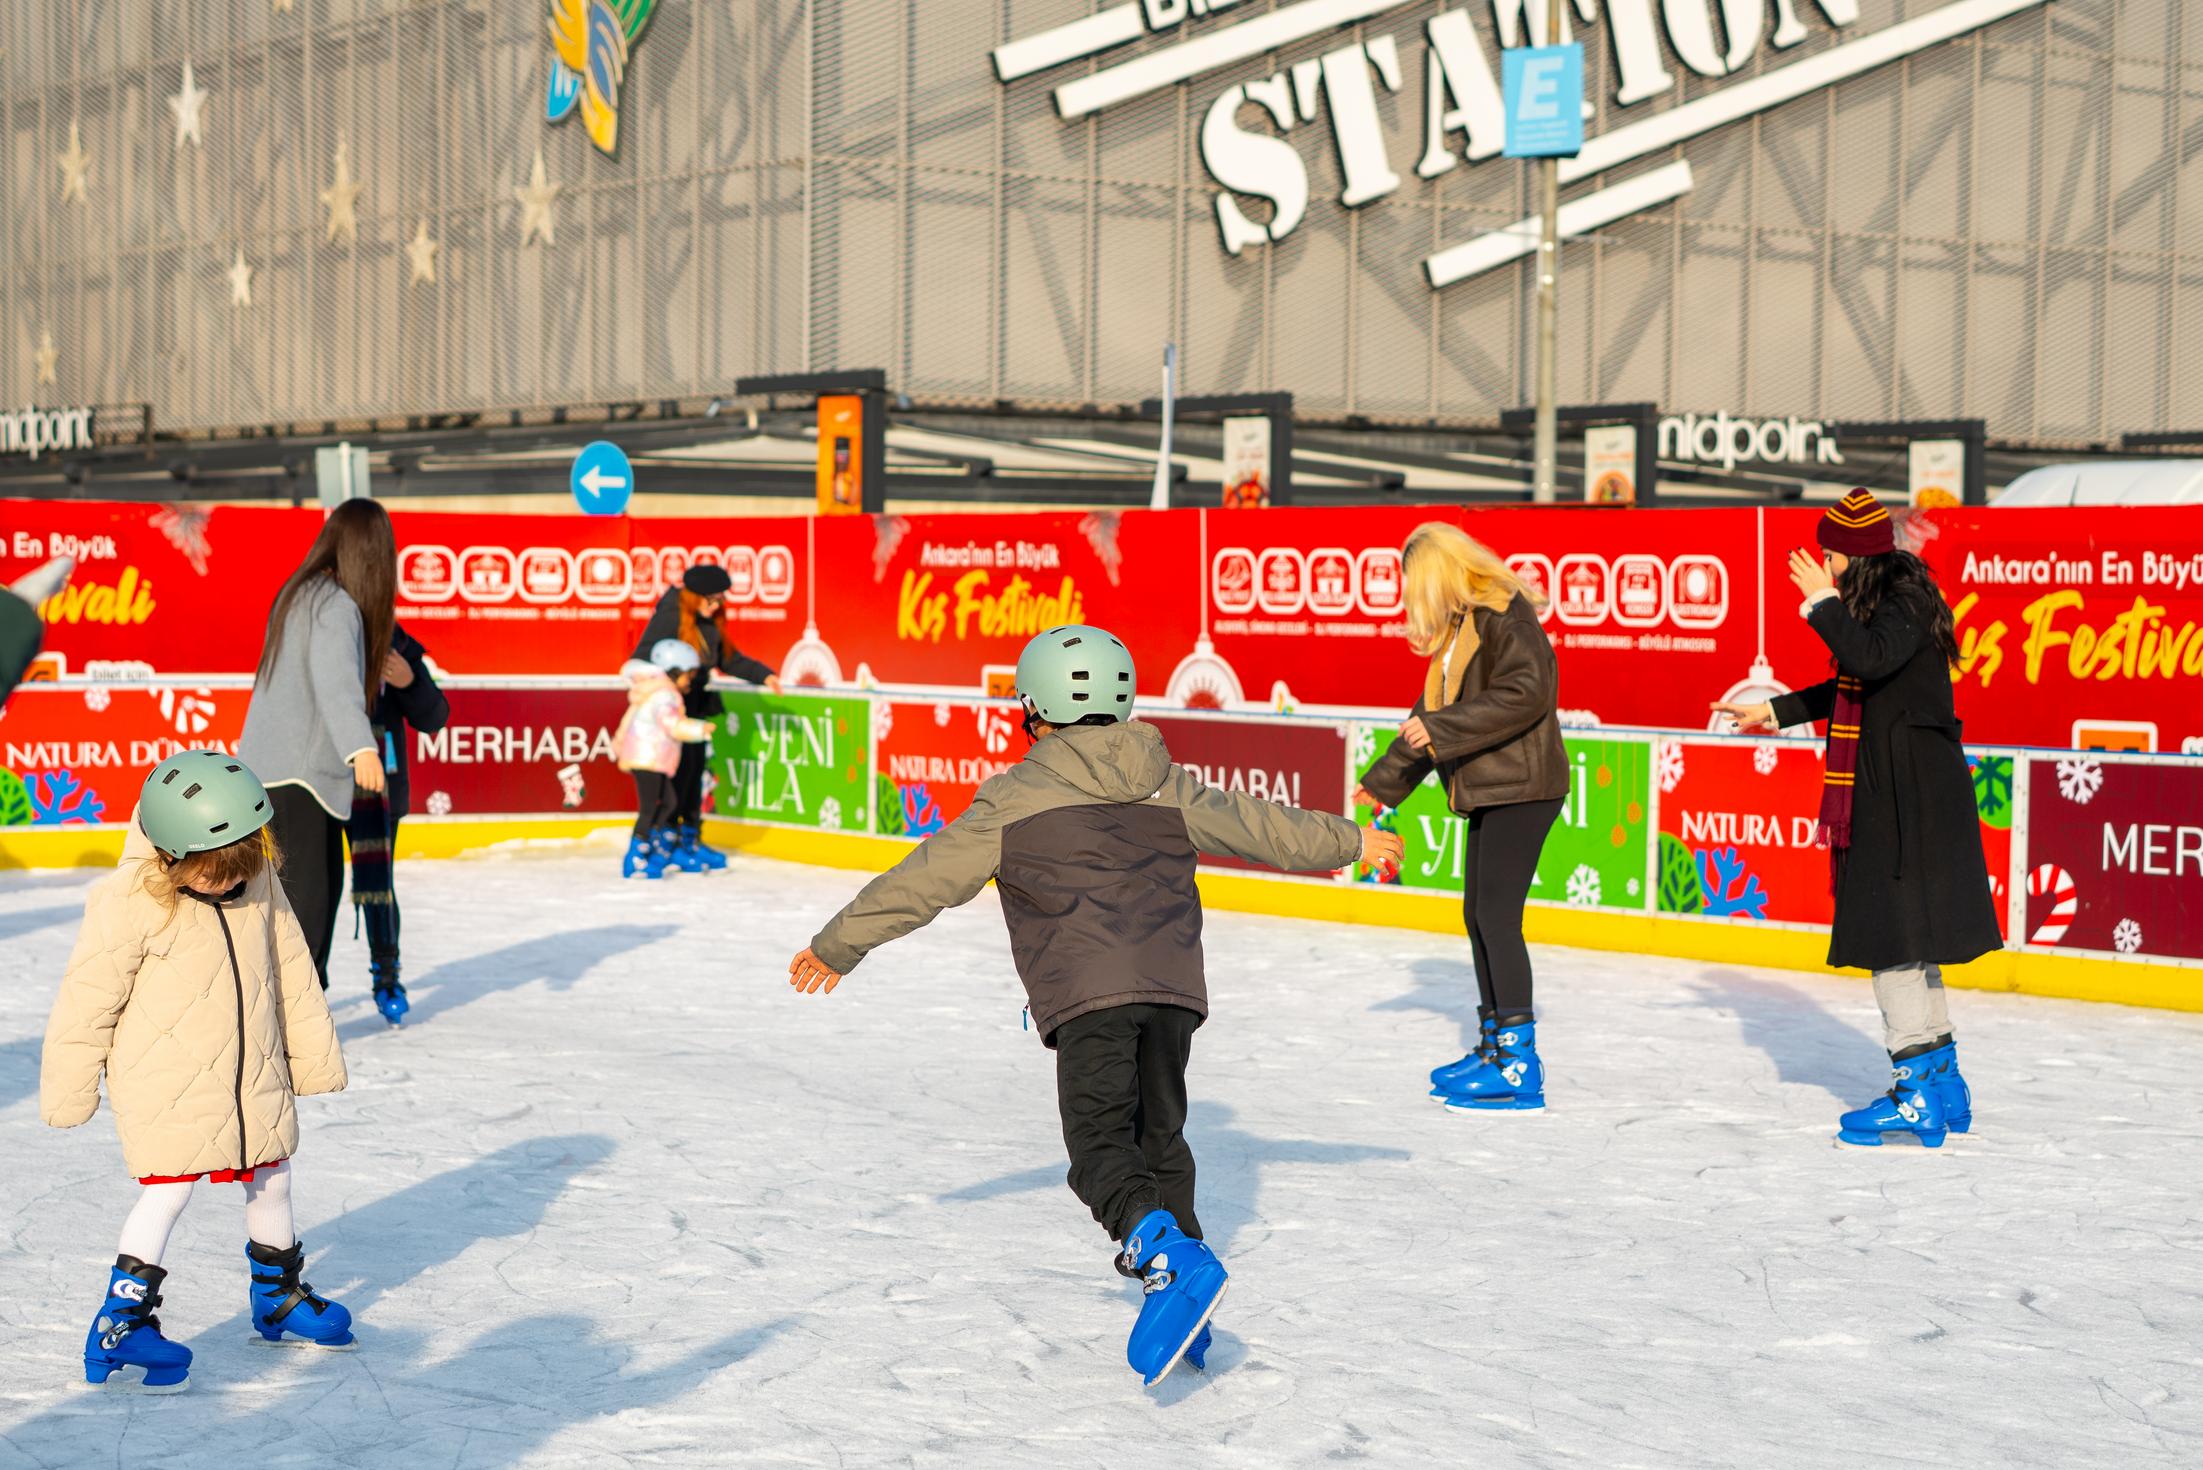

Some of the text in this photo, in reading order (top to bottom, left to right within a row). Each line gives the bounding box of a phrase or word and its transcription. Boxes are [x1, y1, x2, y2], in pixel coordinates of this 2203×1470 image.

[1518, 54, 1566, 121] E
[1200, 0, 1860, 255] STAIO
[13, 531, 43, 559] En
[49, 531, 118, 564] Büyük
[994, 540, 1015, 568] En
[1016, 540, 1060, 572] Büyük
[1961, 550, 2094, 585] Ankara'nın
[2101, 550, 2134, 585] En
[37, 565, 157, 625] ivali
[897, 568, 1086, 644] Kış Festivali
[5, 739, 123, 769] NATURA
[417, 726, 617, 763] MERHABA
[754, 707, 834, 769] YENİ
[889, 754, 1016, 786] NATURA DÜN
[1681, 809, 1785, 848] NATURA
[2102, 821, 2203, 878] MER
